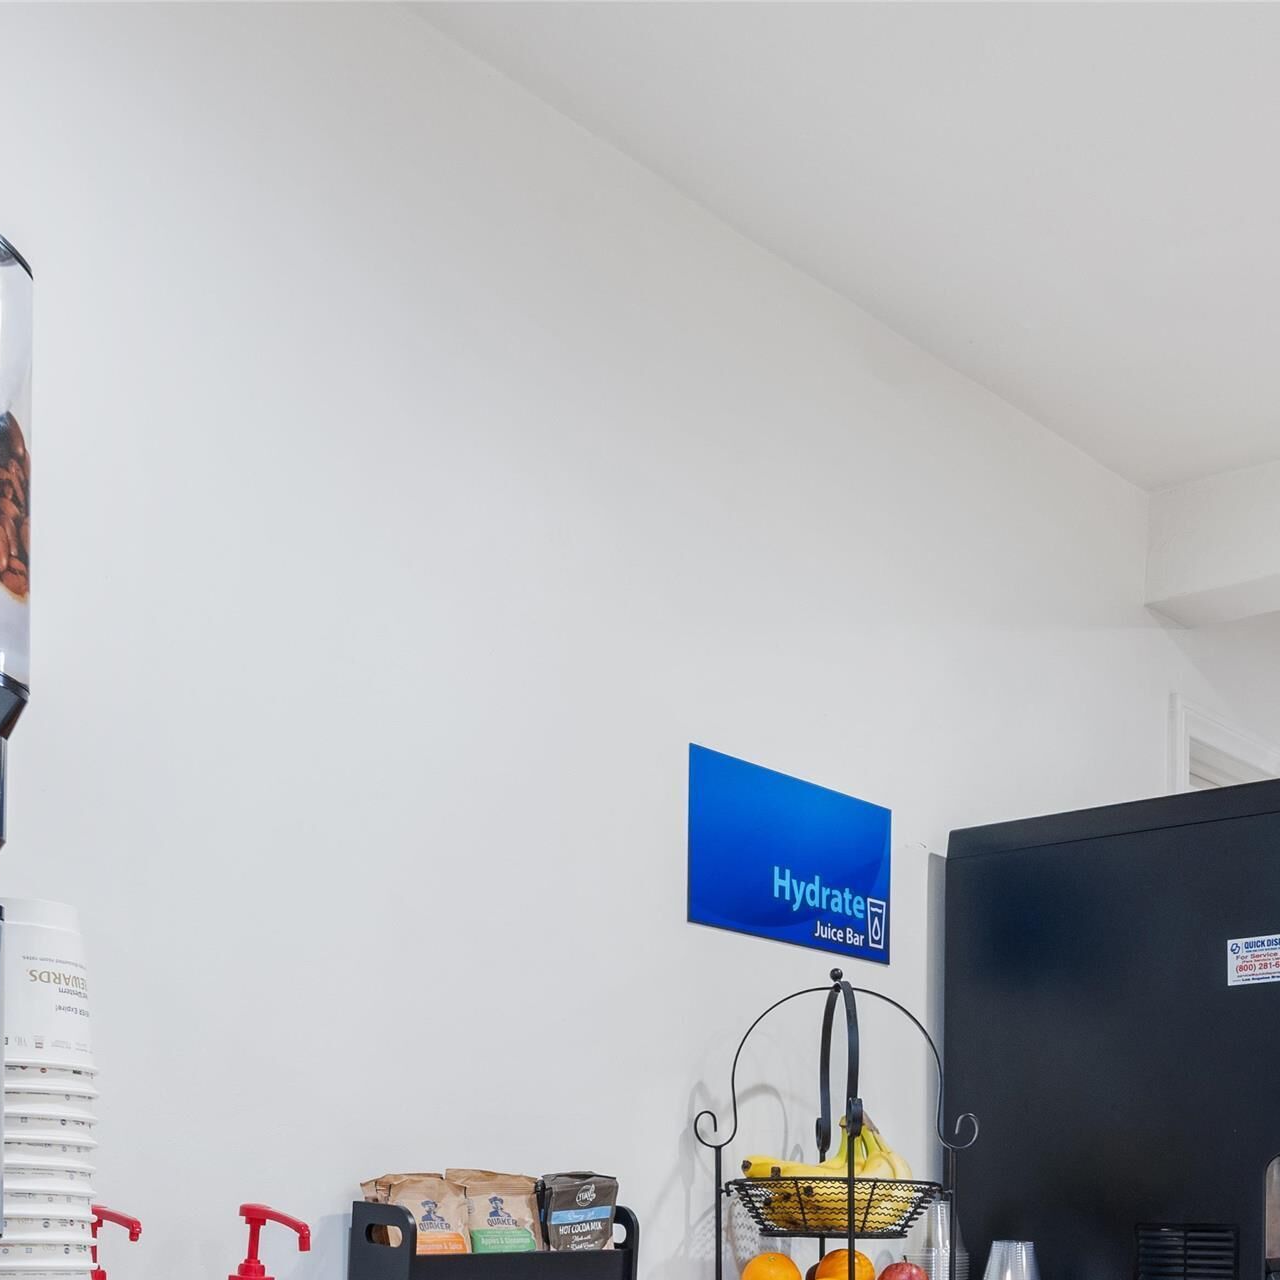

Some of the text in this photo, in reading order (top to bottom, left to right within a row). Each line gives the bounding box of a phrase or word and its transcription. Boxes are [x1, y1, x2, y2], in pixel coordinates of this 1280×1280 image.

[773, 865, 866, 919] Hydrate
[815, 920, 865, 947] Juice Bar
[1244, 940, 1266, 949] QUICK
[1250, 951, 1278, 959] Service
[1236, 963, 1257, 974] (800)
[419, 1222, 451, 1232] QUAKER
[487, 1218, 518, 1227] QUAKER
[559, 1221, 602, 1234] HOT COCOA MIX
